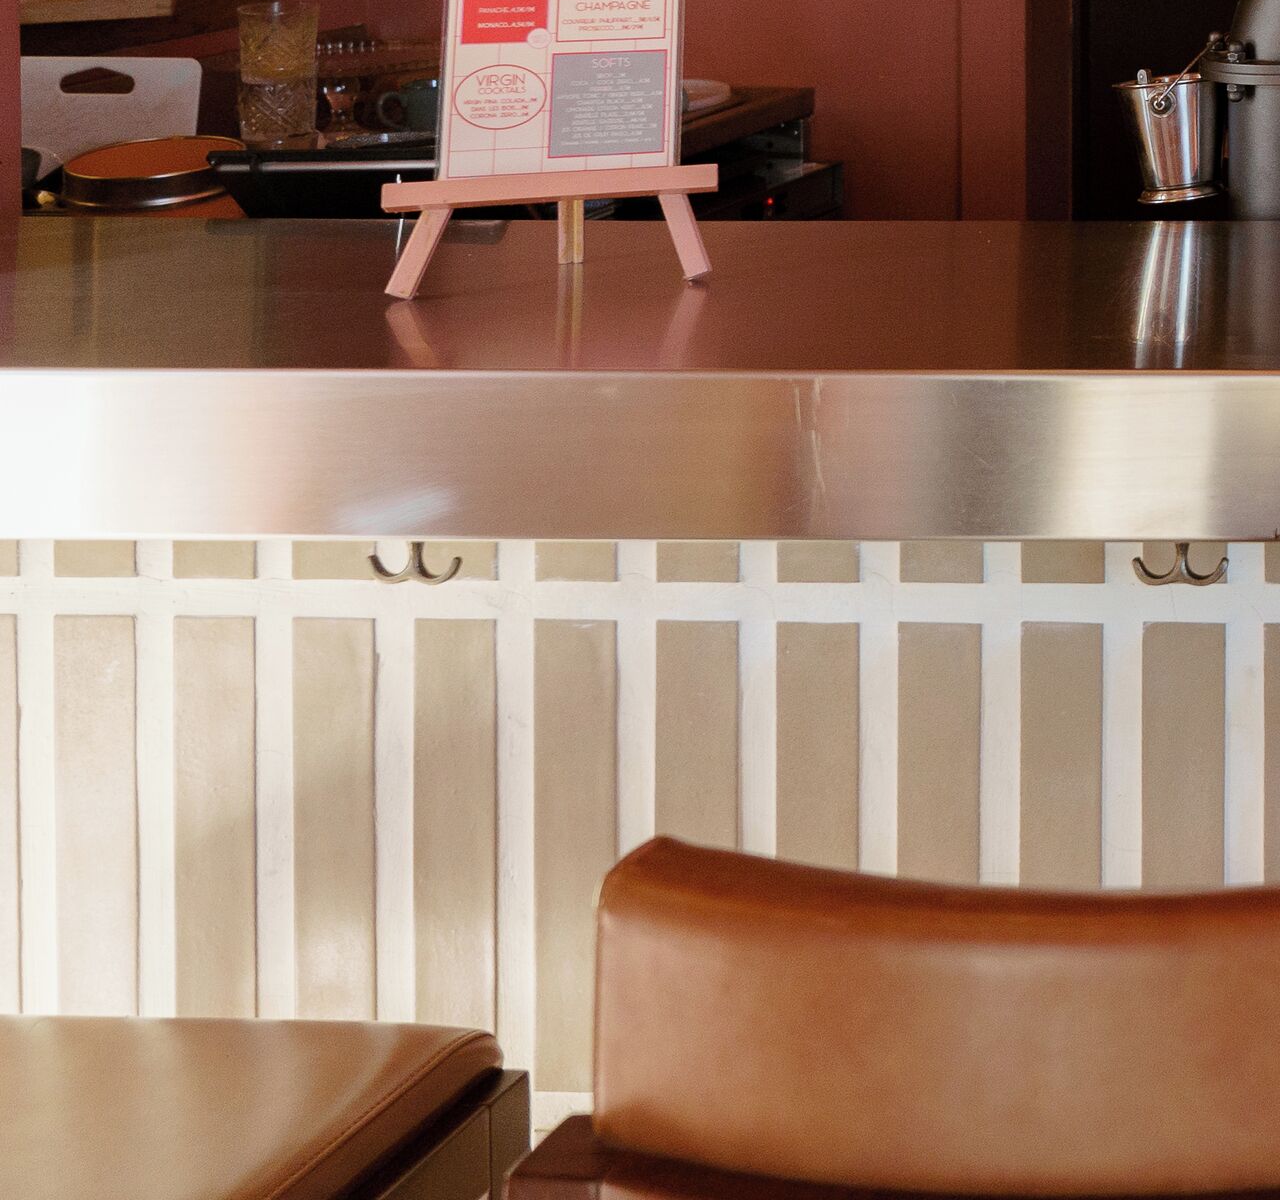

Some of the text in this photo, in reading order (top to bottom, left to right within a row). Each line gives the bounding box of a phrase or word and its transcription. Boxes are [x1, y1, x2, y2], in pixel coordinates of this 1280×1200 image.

[576, 0, 651, 11] CHAMPAGNE
[591, 57, 632, 69] SOFTS
[476, 73, 527, 86] VIRGIN
[478, 86, 527, 95] COCKTAILS
